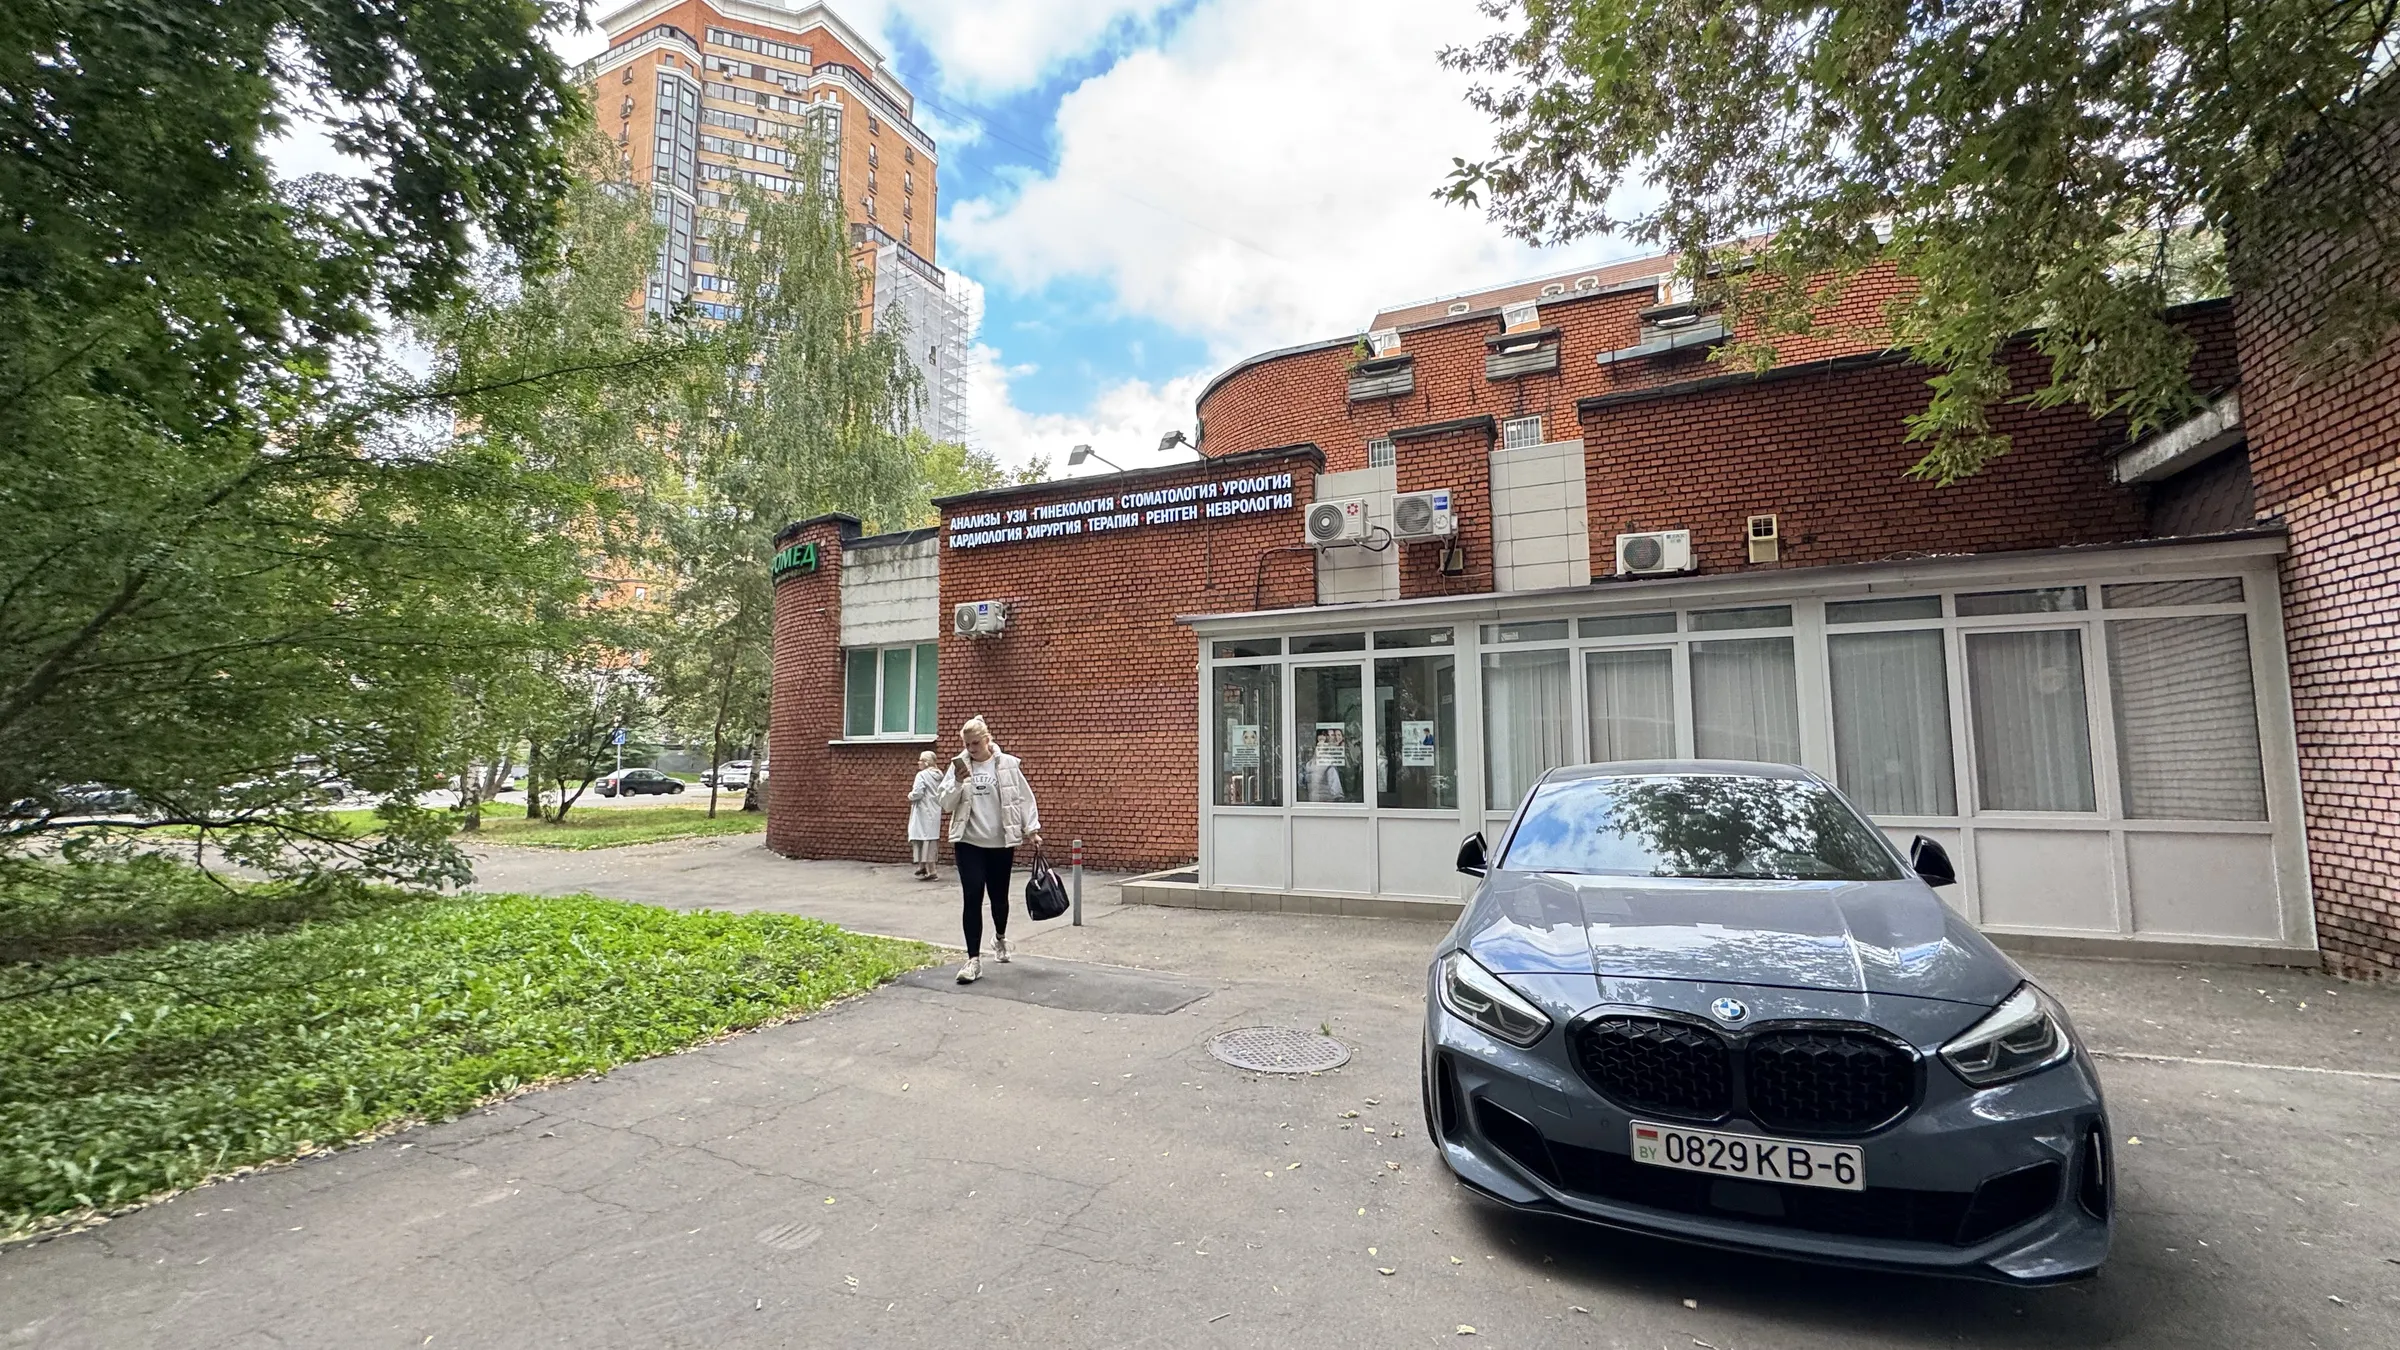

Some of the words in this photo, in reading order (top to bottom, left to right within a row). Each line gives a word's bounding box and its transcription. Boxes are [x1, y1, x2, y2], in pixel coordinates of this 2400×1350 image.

[949, 527, 1022, 548] КАРДИОЛОГИЯ
[1026, 520, 1081, 539] ХИРУРГИЯ
[1087, 512, 1139, 532] ТЕРАПИЯ
[1146, 505, 1198, 525] РЕНТГЕН
[1206, 493, 1292, 518] НЕВРОЛОГИЯ
[950, 512, 1000, 530] АНАЛИЗЫ
[1006, 509, 1027, 523] УЗИ
[1034, 497, 1114, 520] ГИНЕКОЛОГИЯ
[1121, 483, 1217, 509] СТОМАТОЛОГИЯ
[1222, 473, 1291, 496] УРОЛОГИЯ
[1639, 1146, 1657, 1160] BY
